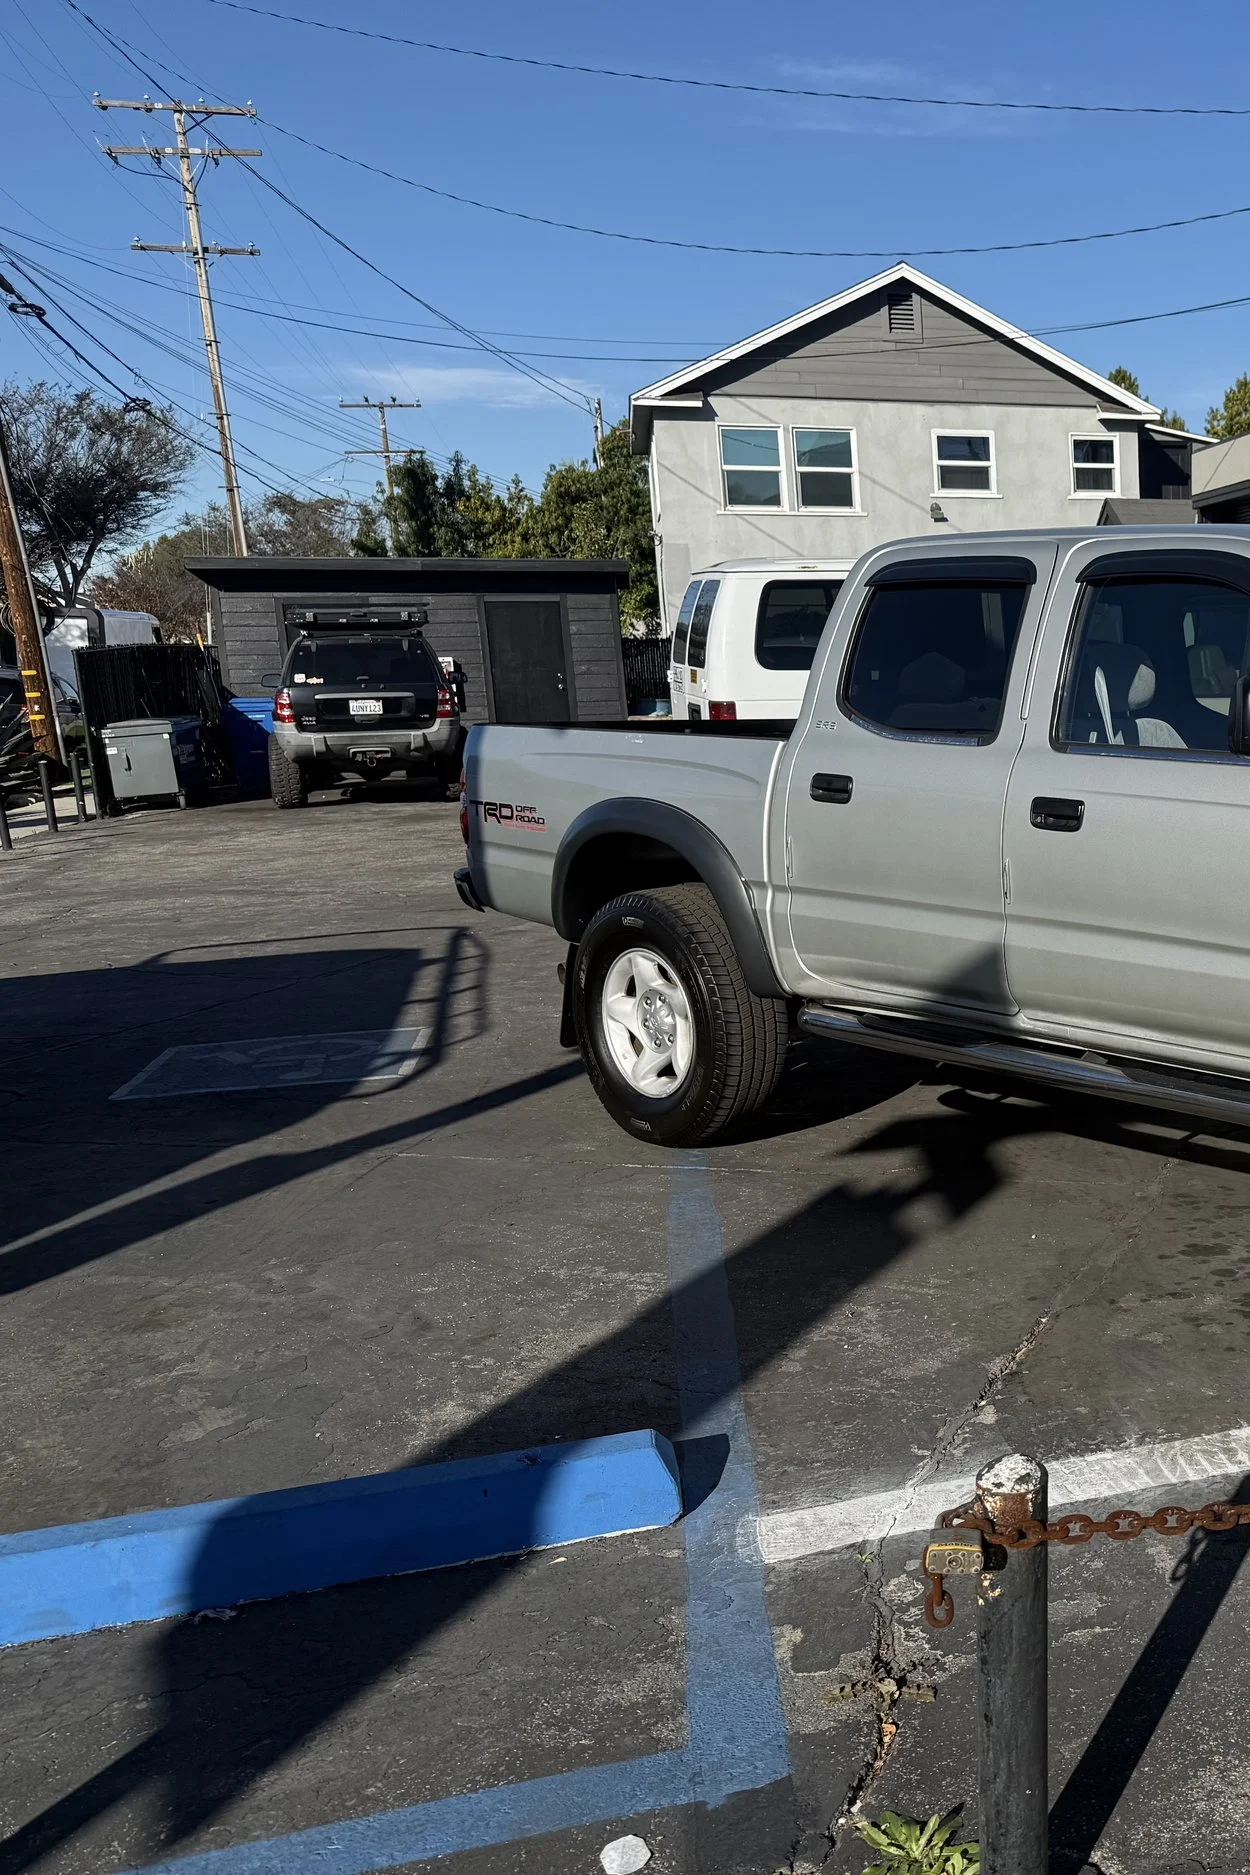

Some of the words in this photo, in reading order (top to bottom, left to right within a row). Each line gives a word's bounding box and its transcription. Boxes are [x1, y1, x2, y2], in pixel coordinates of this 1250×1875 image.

[469, 799, 514, 824] TRD
[515, 805, 537, 814] OFF
[515, 814, 545, 825] ROAD
